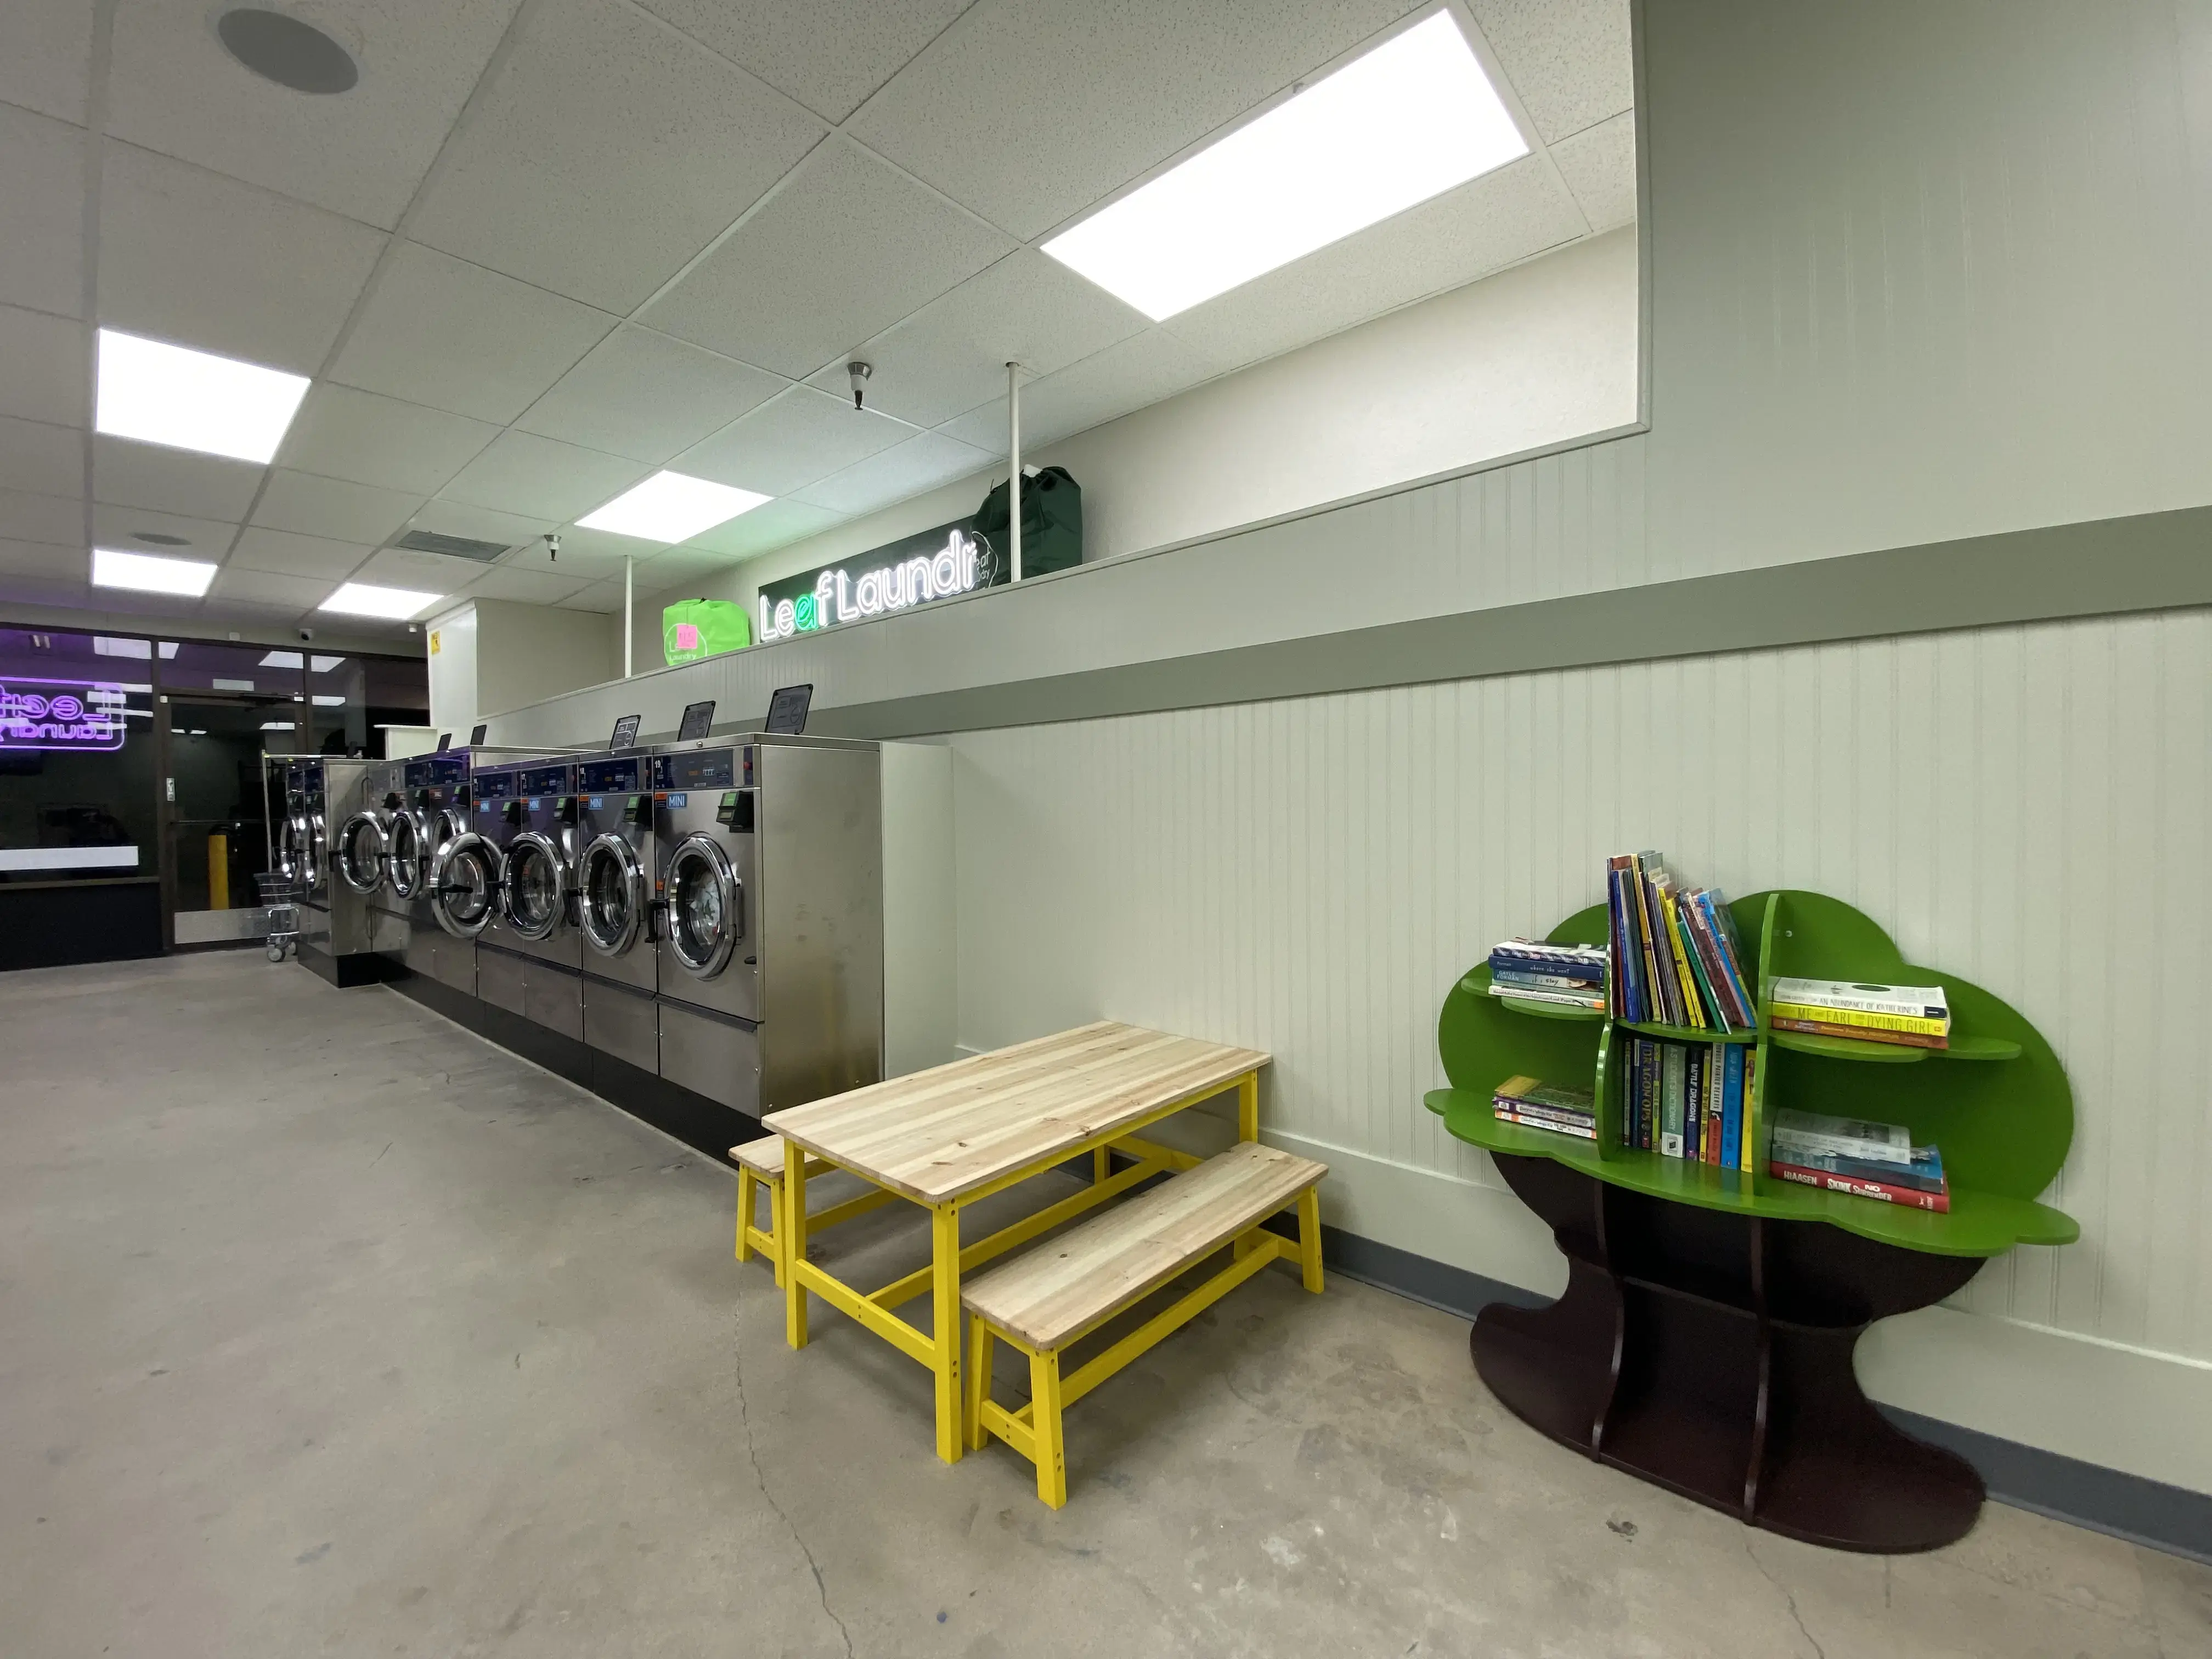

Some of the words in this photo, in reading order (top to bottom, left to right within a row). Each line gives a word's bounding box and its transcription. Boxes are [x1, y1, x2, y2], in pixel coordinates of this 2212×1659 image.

[760, 571, 833, 642] Leaf
[837, 528, 977, 622] Laundr
[669, 652, 697, 661] Laundry
[654, 760, 661, 769] 19
[590, 798, 602, 808] MINI
[669, 795, 685, 807] MINI
[1545, 978, 1559, 986] stay
[1830, 999, 1864, 1011] ABUNDANCE
[1876, 1003, 1918, 1014] KATHERINES
[1798, 1007, 1812, 1020] ME
[1826, 1011, 1850, 1024] EARL
[1867, 1015, 1902, 1031] DYING
[1906, 1020, 1931, 1034] GIRL
[1642, 1049, 1652, 1098] DRAGON
[1690, 1063, 1699, 1087] BATTLE
[1641, 1099, 1651, 1122] OPS
[1669, 1091, 1677, 1131] DICTIONARY
[1688, 1088, 1698, 1122] DRAGONS
[1784, 1170, 1817, 1186] HIAASEN
[1827, 1178, 1852, 1194] SKINK
[1853, 1184, 1892, 1201] SURRENDER
[1865, 1184, 1880, 1192] NO
